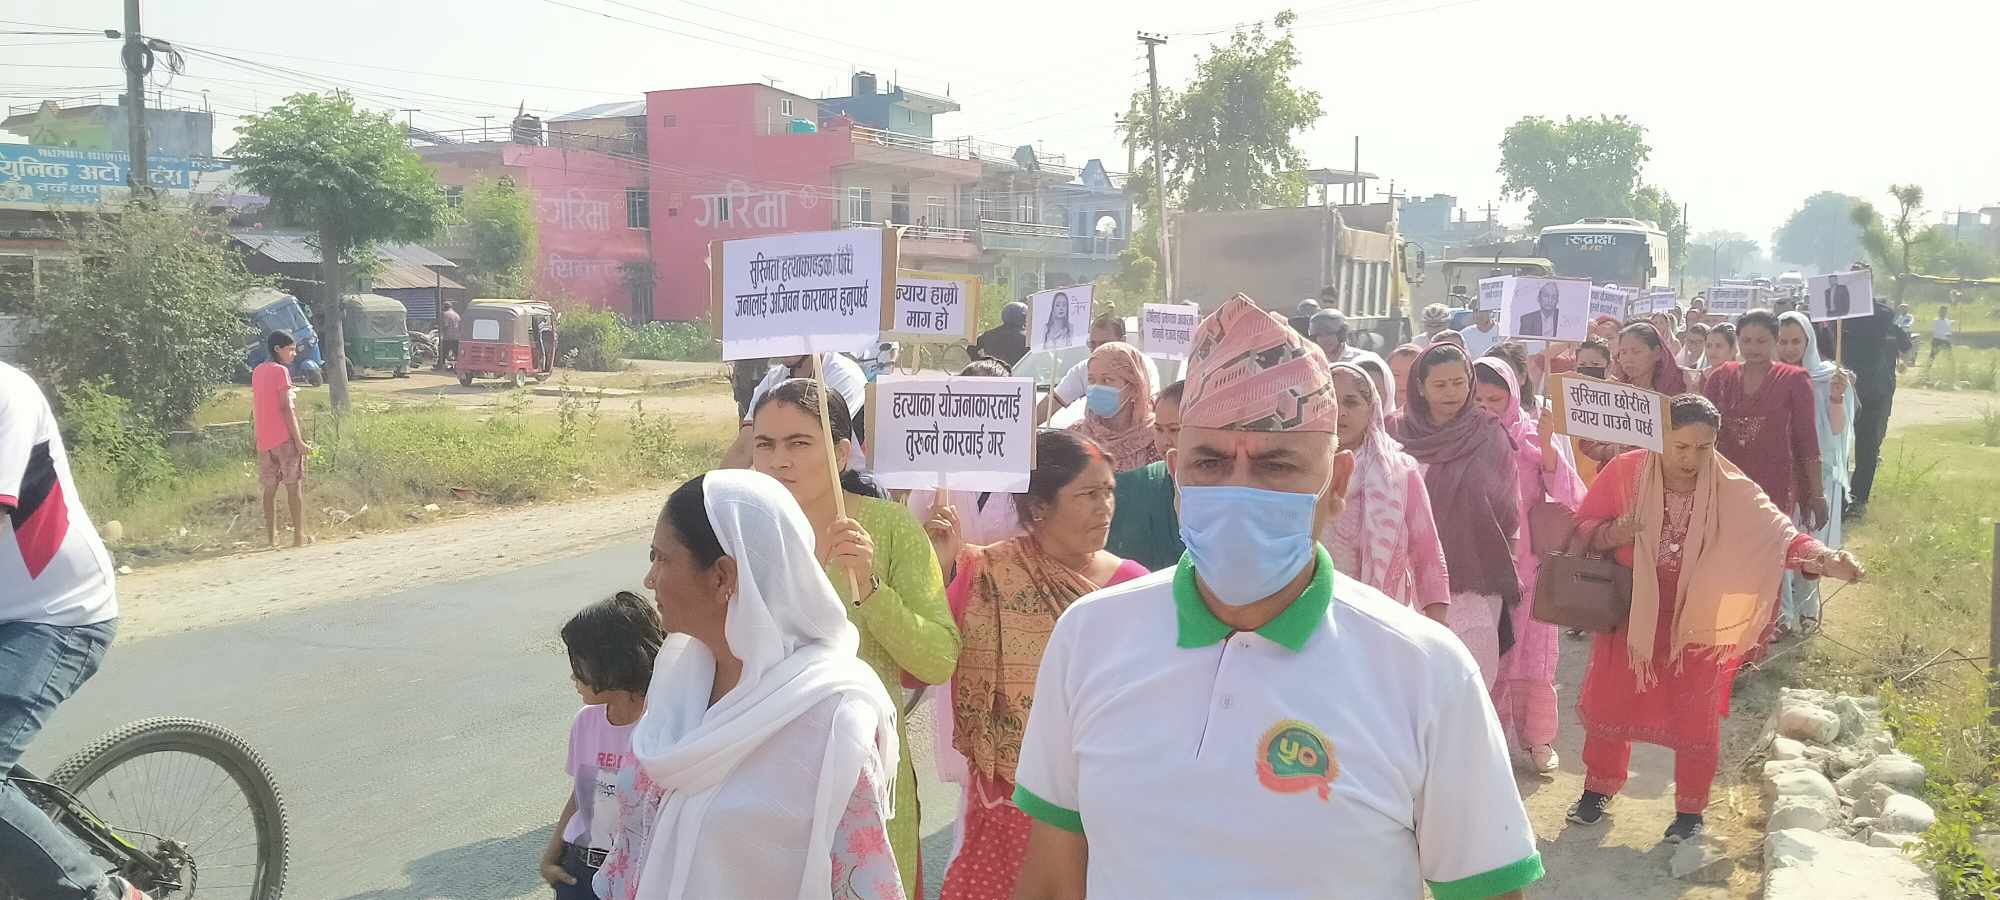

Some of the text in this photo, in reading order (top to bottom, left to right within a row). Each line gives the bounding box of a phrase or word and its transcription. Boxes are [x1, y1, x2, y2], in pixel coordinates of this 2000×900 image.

[690, 183, 788, 230] गरिमा
[750, 251, 780, 290] सुस्मिता
[735, 279, 869, 319] जनालाई अजिवन कारावास हुनुपर्छ
[896, 281, 959, 306] न्याय हाम्रो
[906, 306, 949, 331] माग हो
[893, 384, 1022, 423] हत्याका योजनाकारलाई
[1570, 383, 1650, 415] सुस्मिता छोरीले
[905, 421, 1006, 462] तुरुन्तै कारवाई गर
[1570, 408, 1654, 438] न्याय पाउने पर्छ
